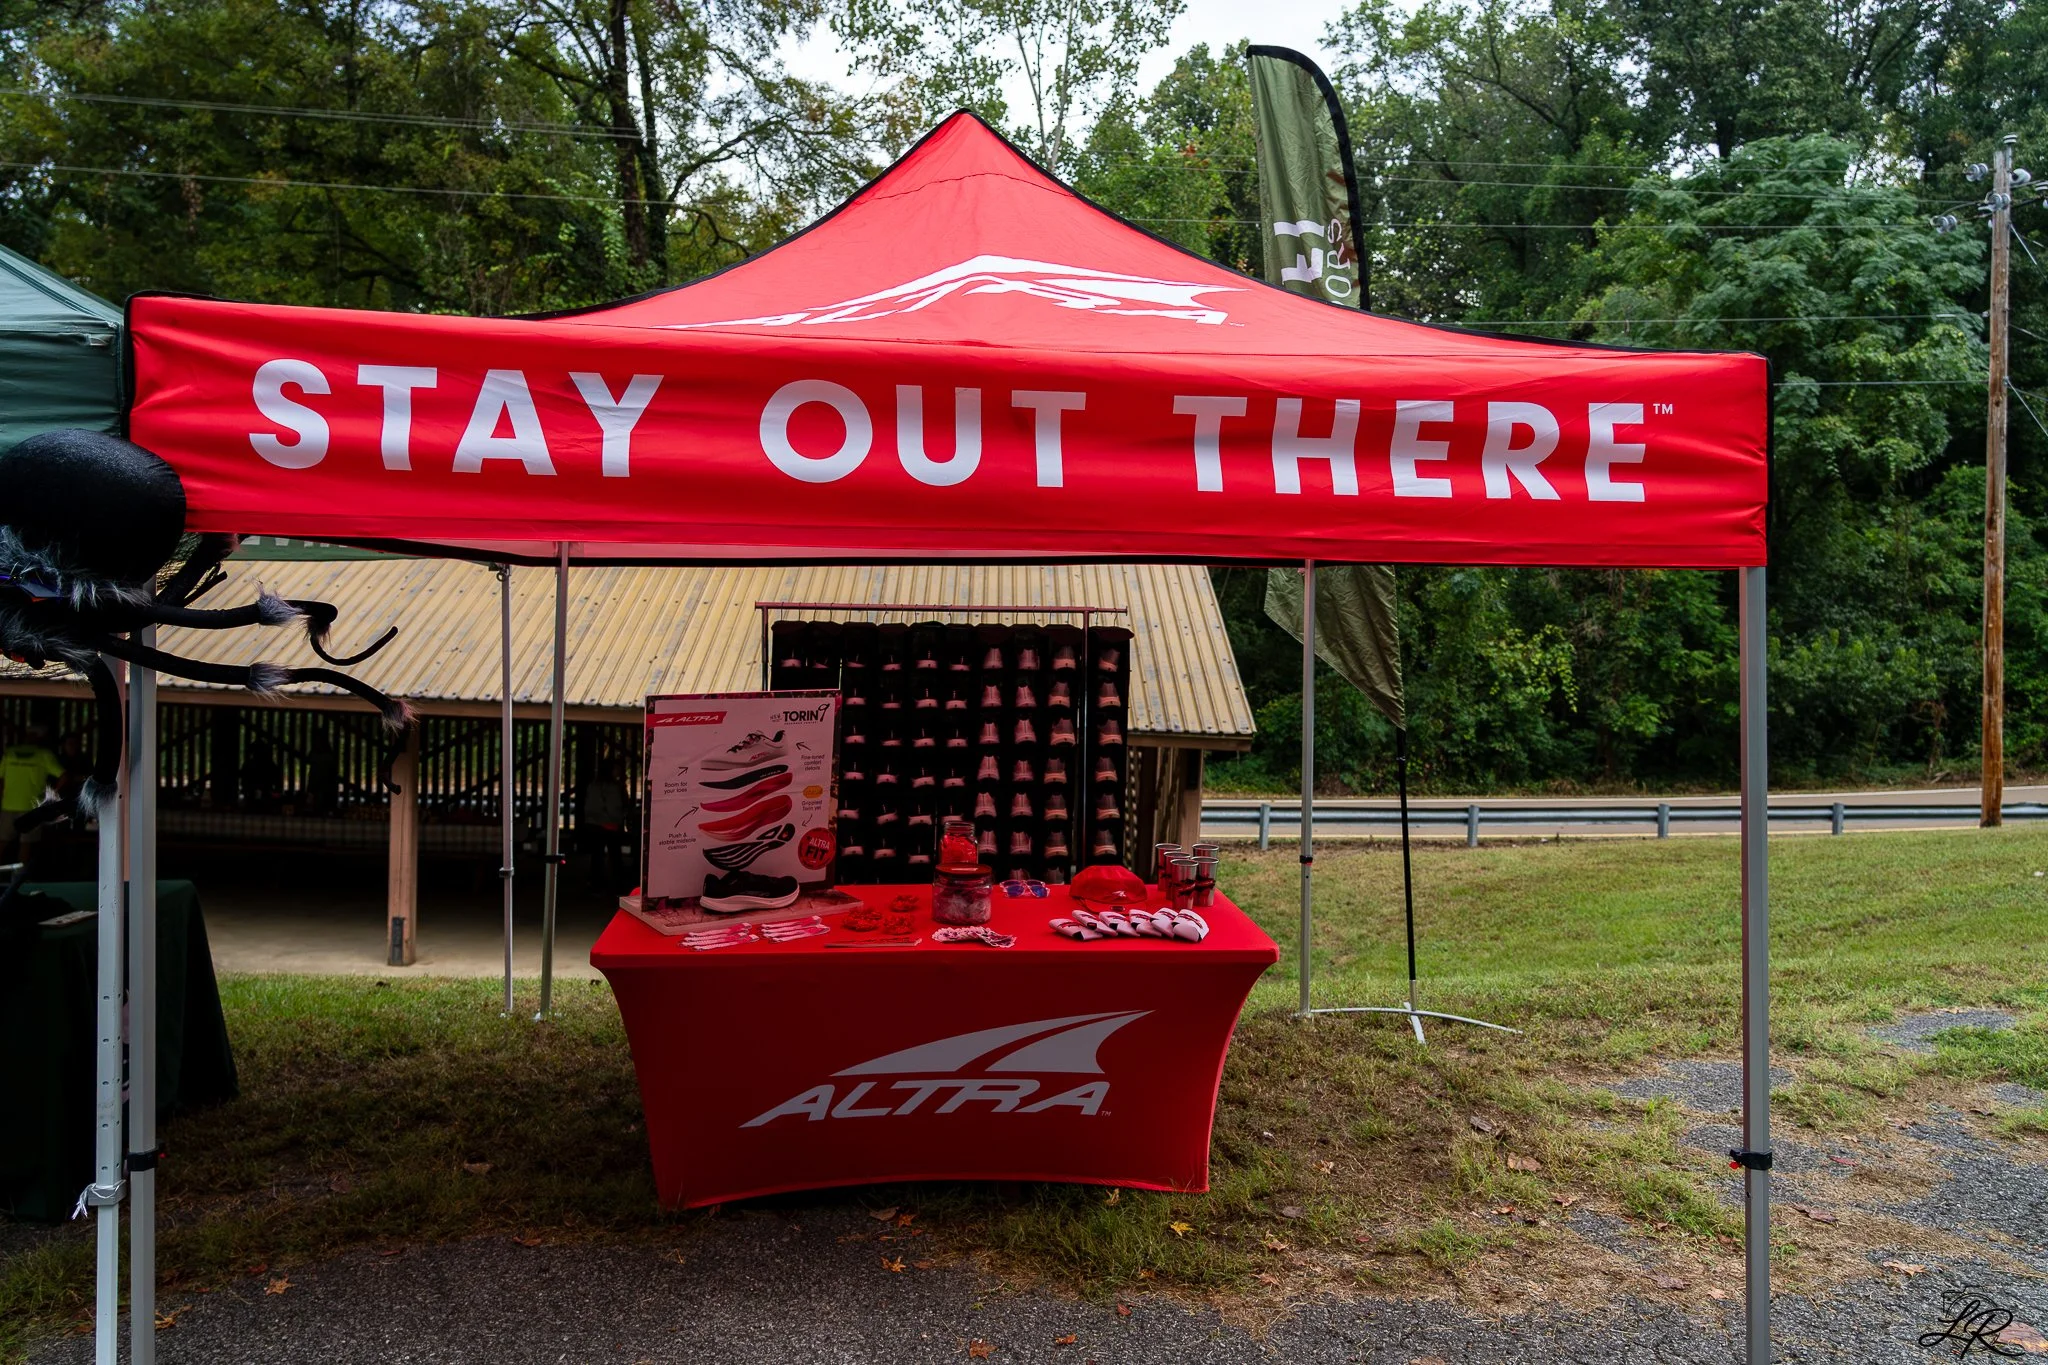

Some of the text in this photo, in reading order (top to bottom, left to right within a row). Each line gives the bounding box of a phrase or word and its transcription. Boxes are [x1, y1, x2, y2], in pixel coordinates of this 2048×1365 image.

[248, 358, 664, 478] STAY
[759, 379, 1086, 489] OUT
[1172, 395, 1646, 503] THERE
[675, 715, 719, 723] ALTRA
[783, 710, 819, 722] TORIN
[809, 837, 830, 849] ALTRA
[806, 845, 829, 861] FIT
[738, 1079, 1111, 1128] ALTRA
